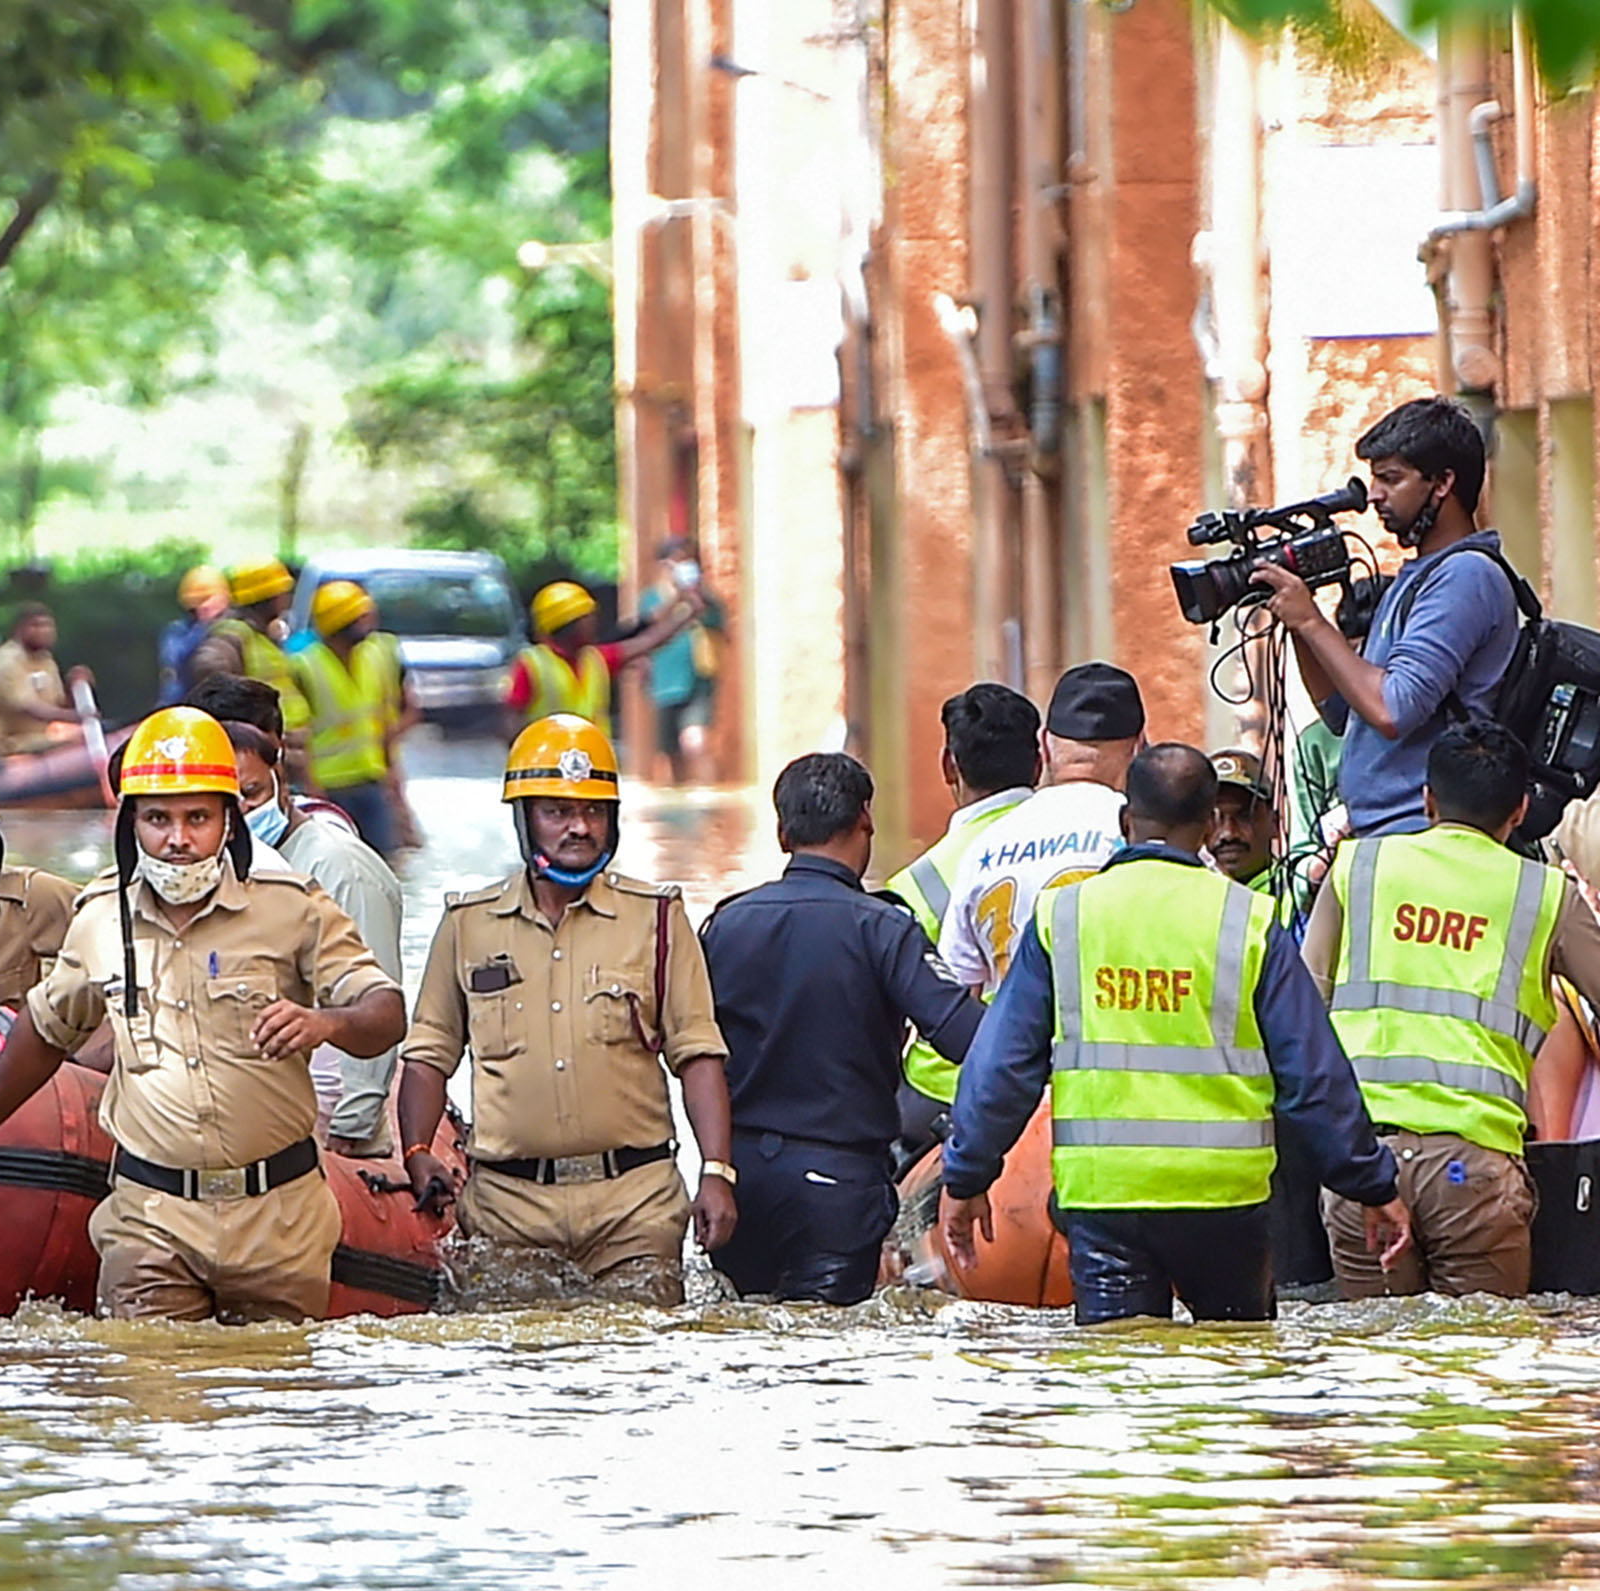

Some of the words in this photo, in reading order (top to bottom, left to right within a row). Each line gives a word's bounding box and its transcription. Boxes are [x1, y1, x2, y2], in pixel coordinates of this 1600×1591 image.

[996, 830, 1102, 866] HAWAII
[1394, 902, 1489, 952] SDRF
[1095, 966, 1192, 1012] SDRF
